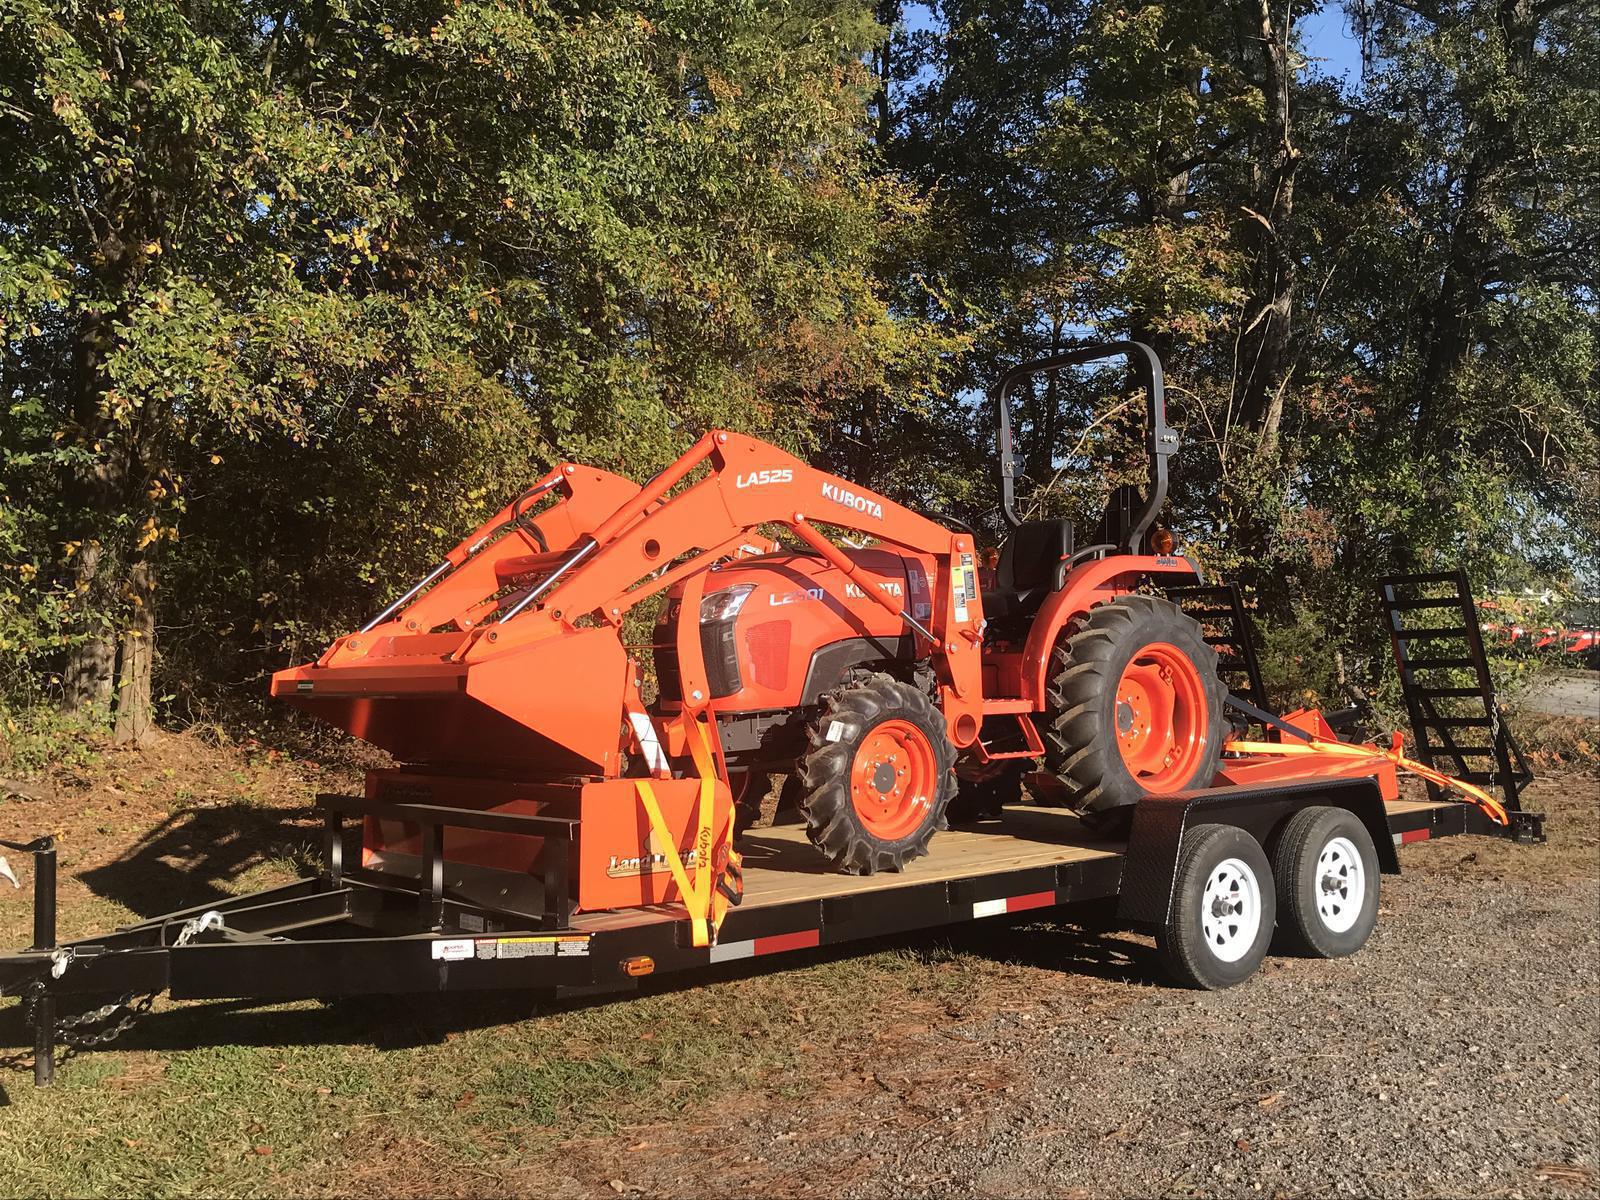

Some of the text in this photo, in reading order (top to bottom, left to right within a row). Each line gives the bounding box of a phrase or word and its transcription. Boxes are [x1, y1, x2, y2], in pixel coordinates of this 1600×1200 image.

[736, 469, 793, 488] LA525
[822, 482, 883, 520] KUBOTA
[845, 582, 903, 598] KUTA
[608, 853, 652, 871] Land
